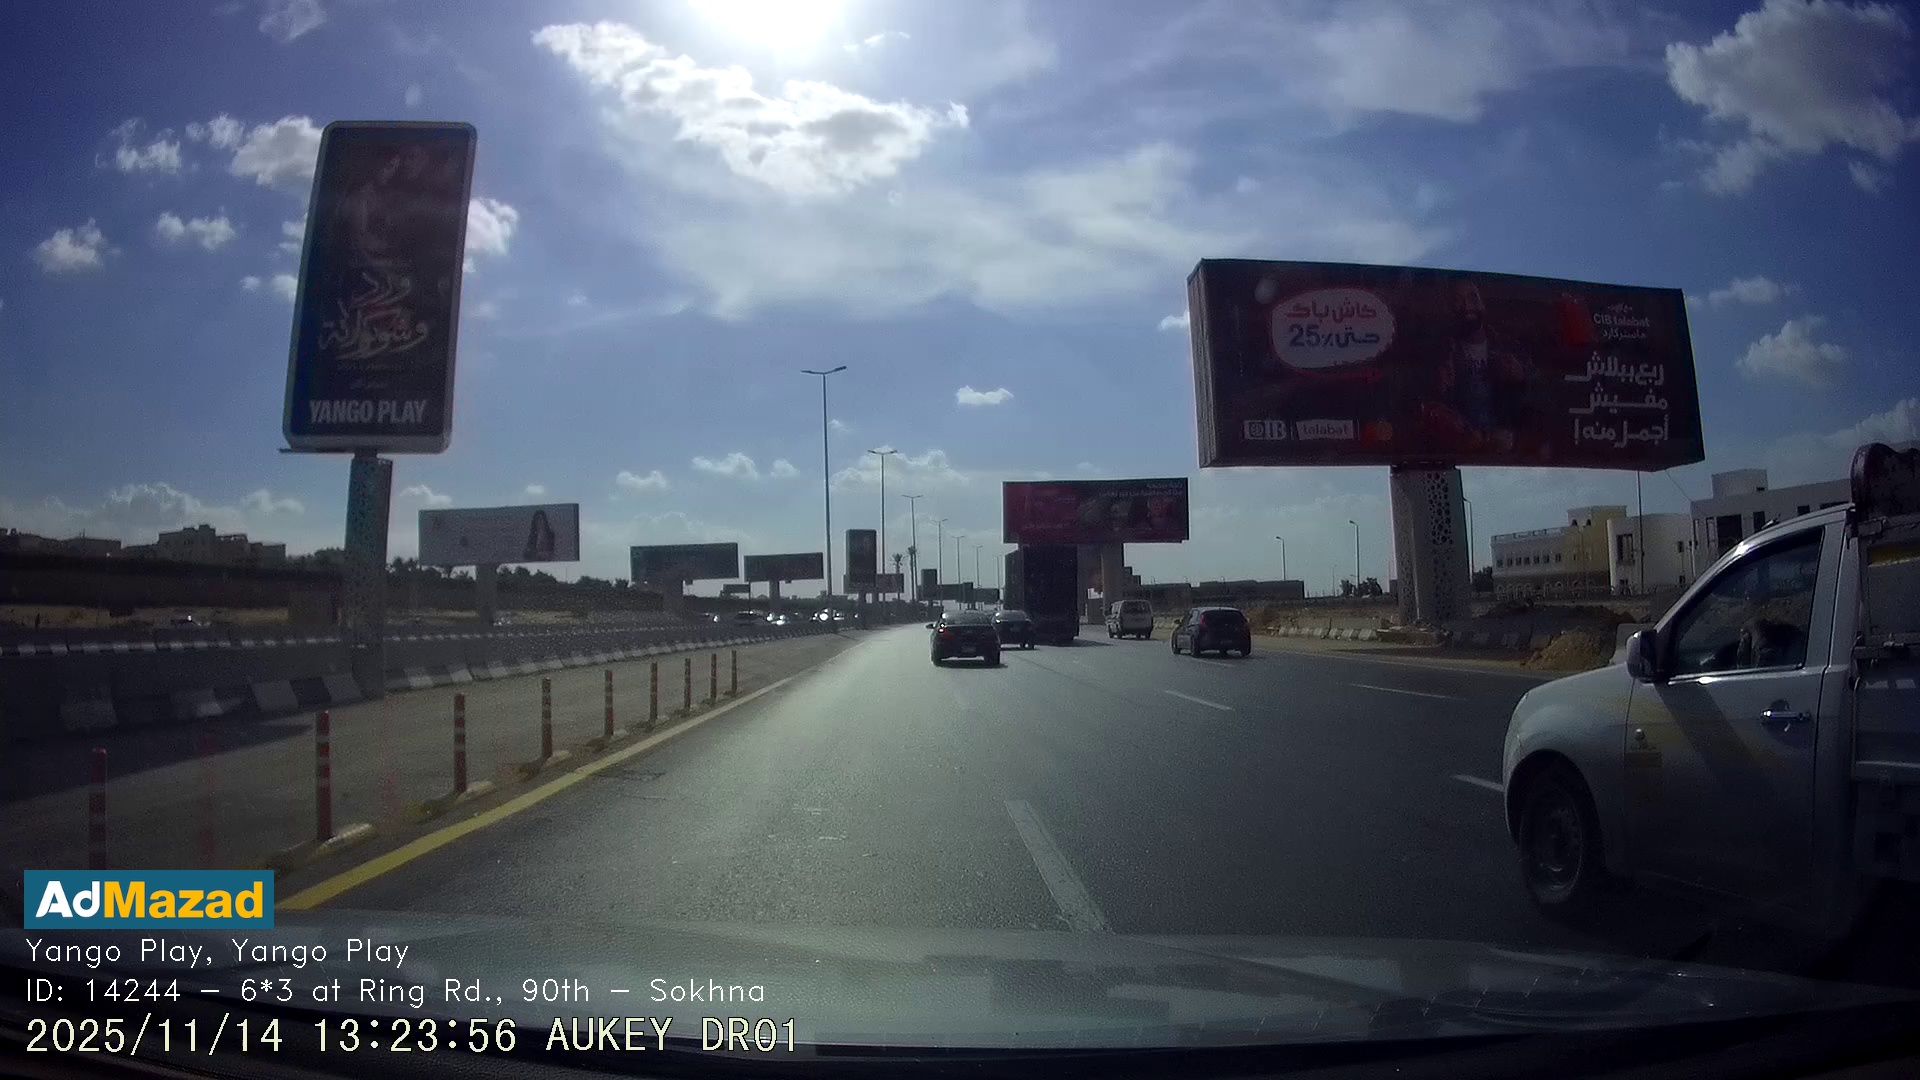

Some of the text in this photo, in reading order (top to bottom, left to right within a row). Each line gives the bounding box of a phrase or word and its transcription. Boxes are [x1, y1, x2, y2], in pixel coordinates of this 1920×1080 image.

[1284, 297, 1377, 323] كاش باك
[1593, 313, 1612, 325] CIB
[1335, 326, 1381, 348] حتى
[1564, 350, 1665, 386] ربع ببلاش
[1568, 382, 1668, 414] مفيش
[309, 399, 427, 424] YANGO PLAY
[1303, 423, 1348, 436] talabat
[1614, 413, 1669, 448] أجمل
